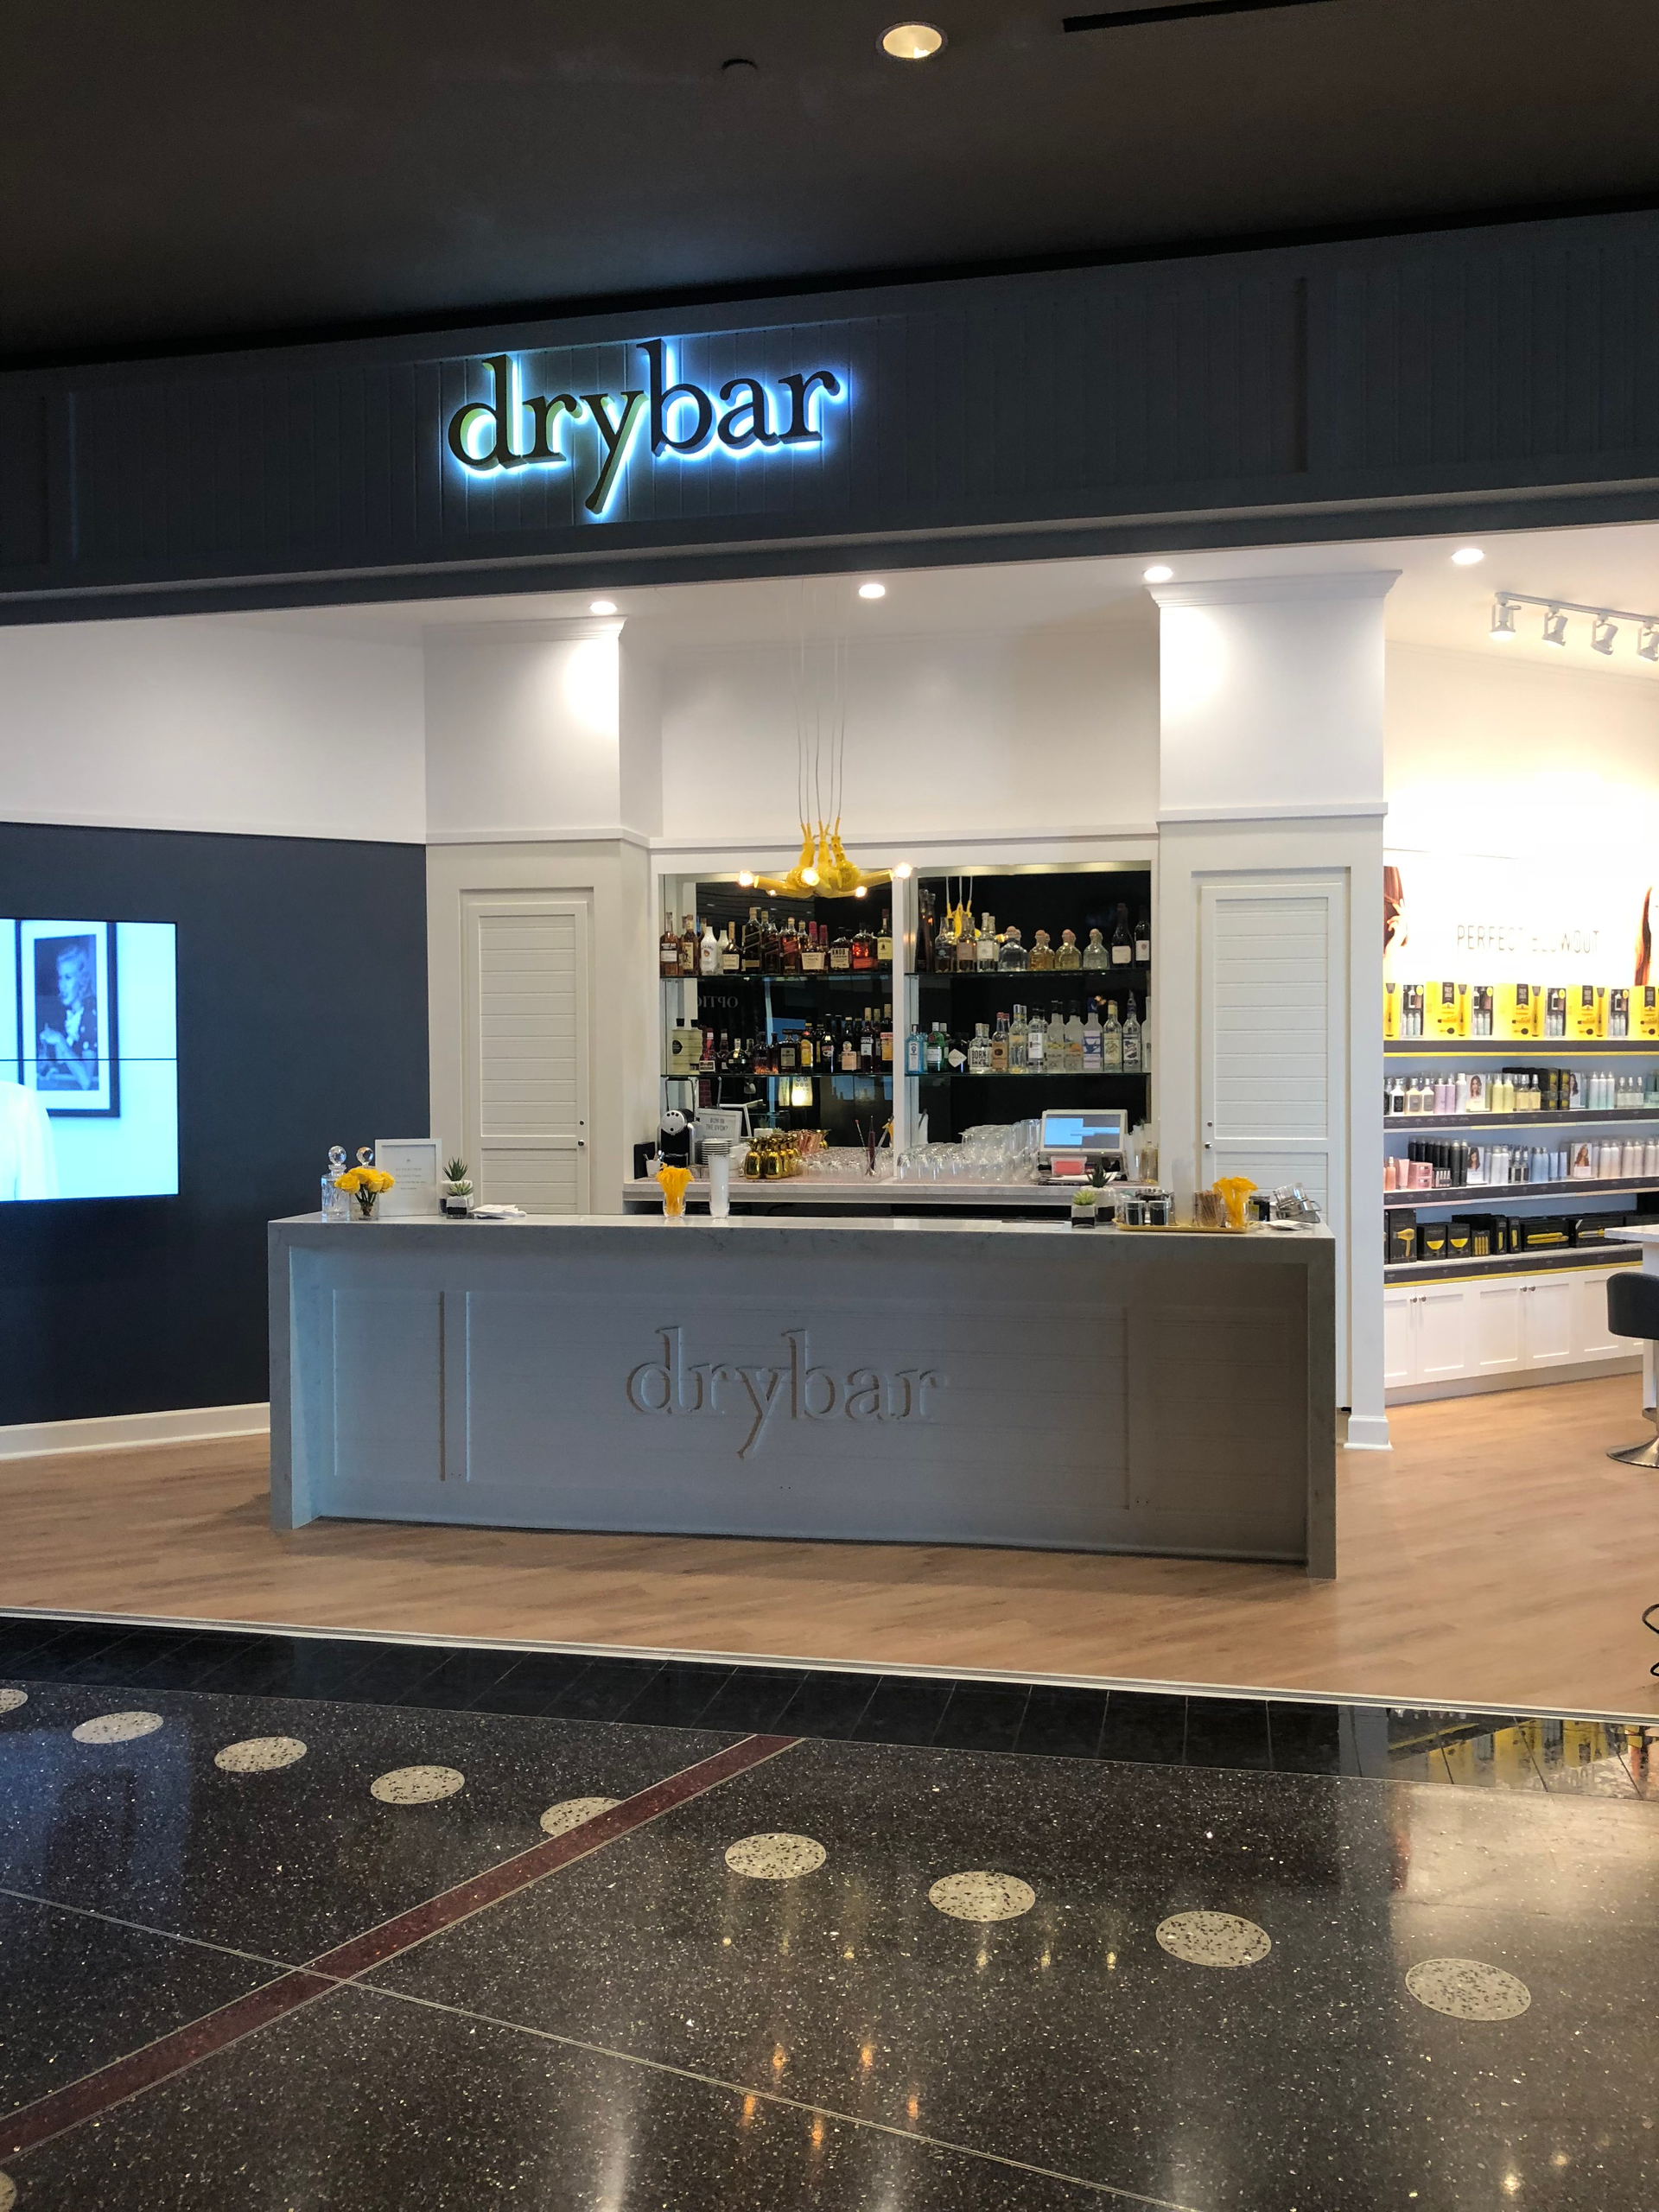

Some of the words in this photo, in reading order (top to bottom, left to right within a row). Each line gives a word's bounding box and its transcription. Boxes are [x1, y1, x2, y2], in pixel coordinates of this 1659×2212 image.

[448, 338, 840, 514] drybar
[1532, 930, 1599, 954] BWOUT
[626, 1326, 950, 1459] drybar
